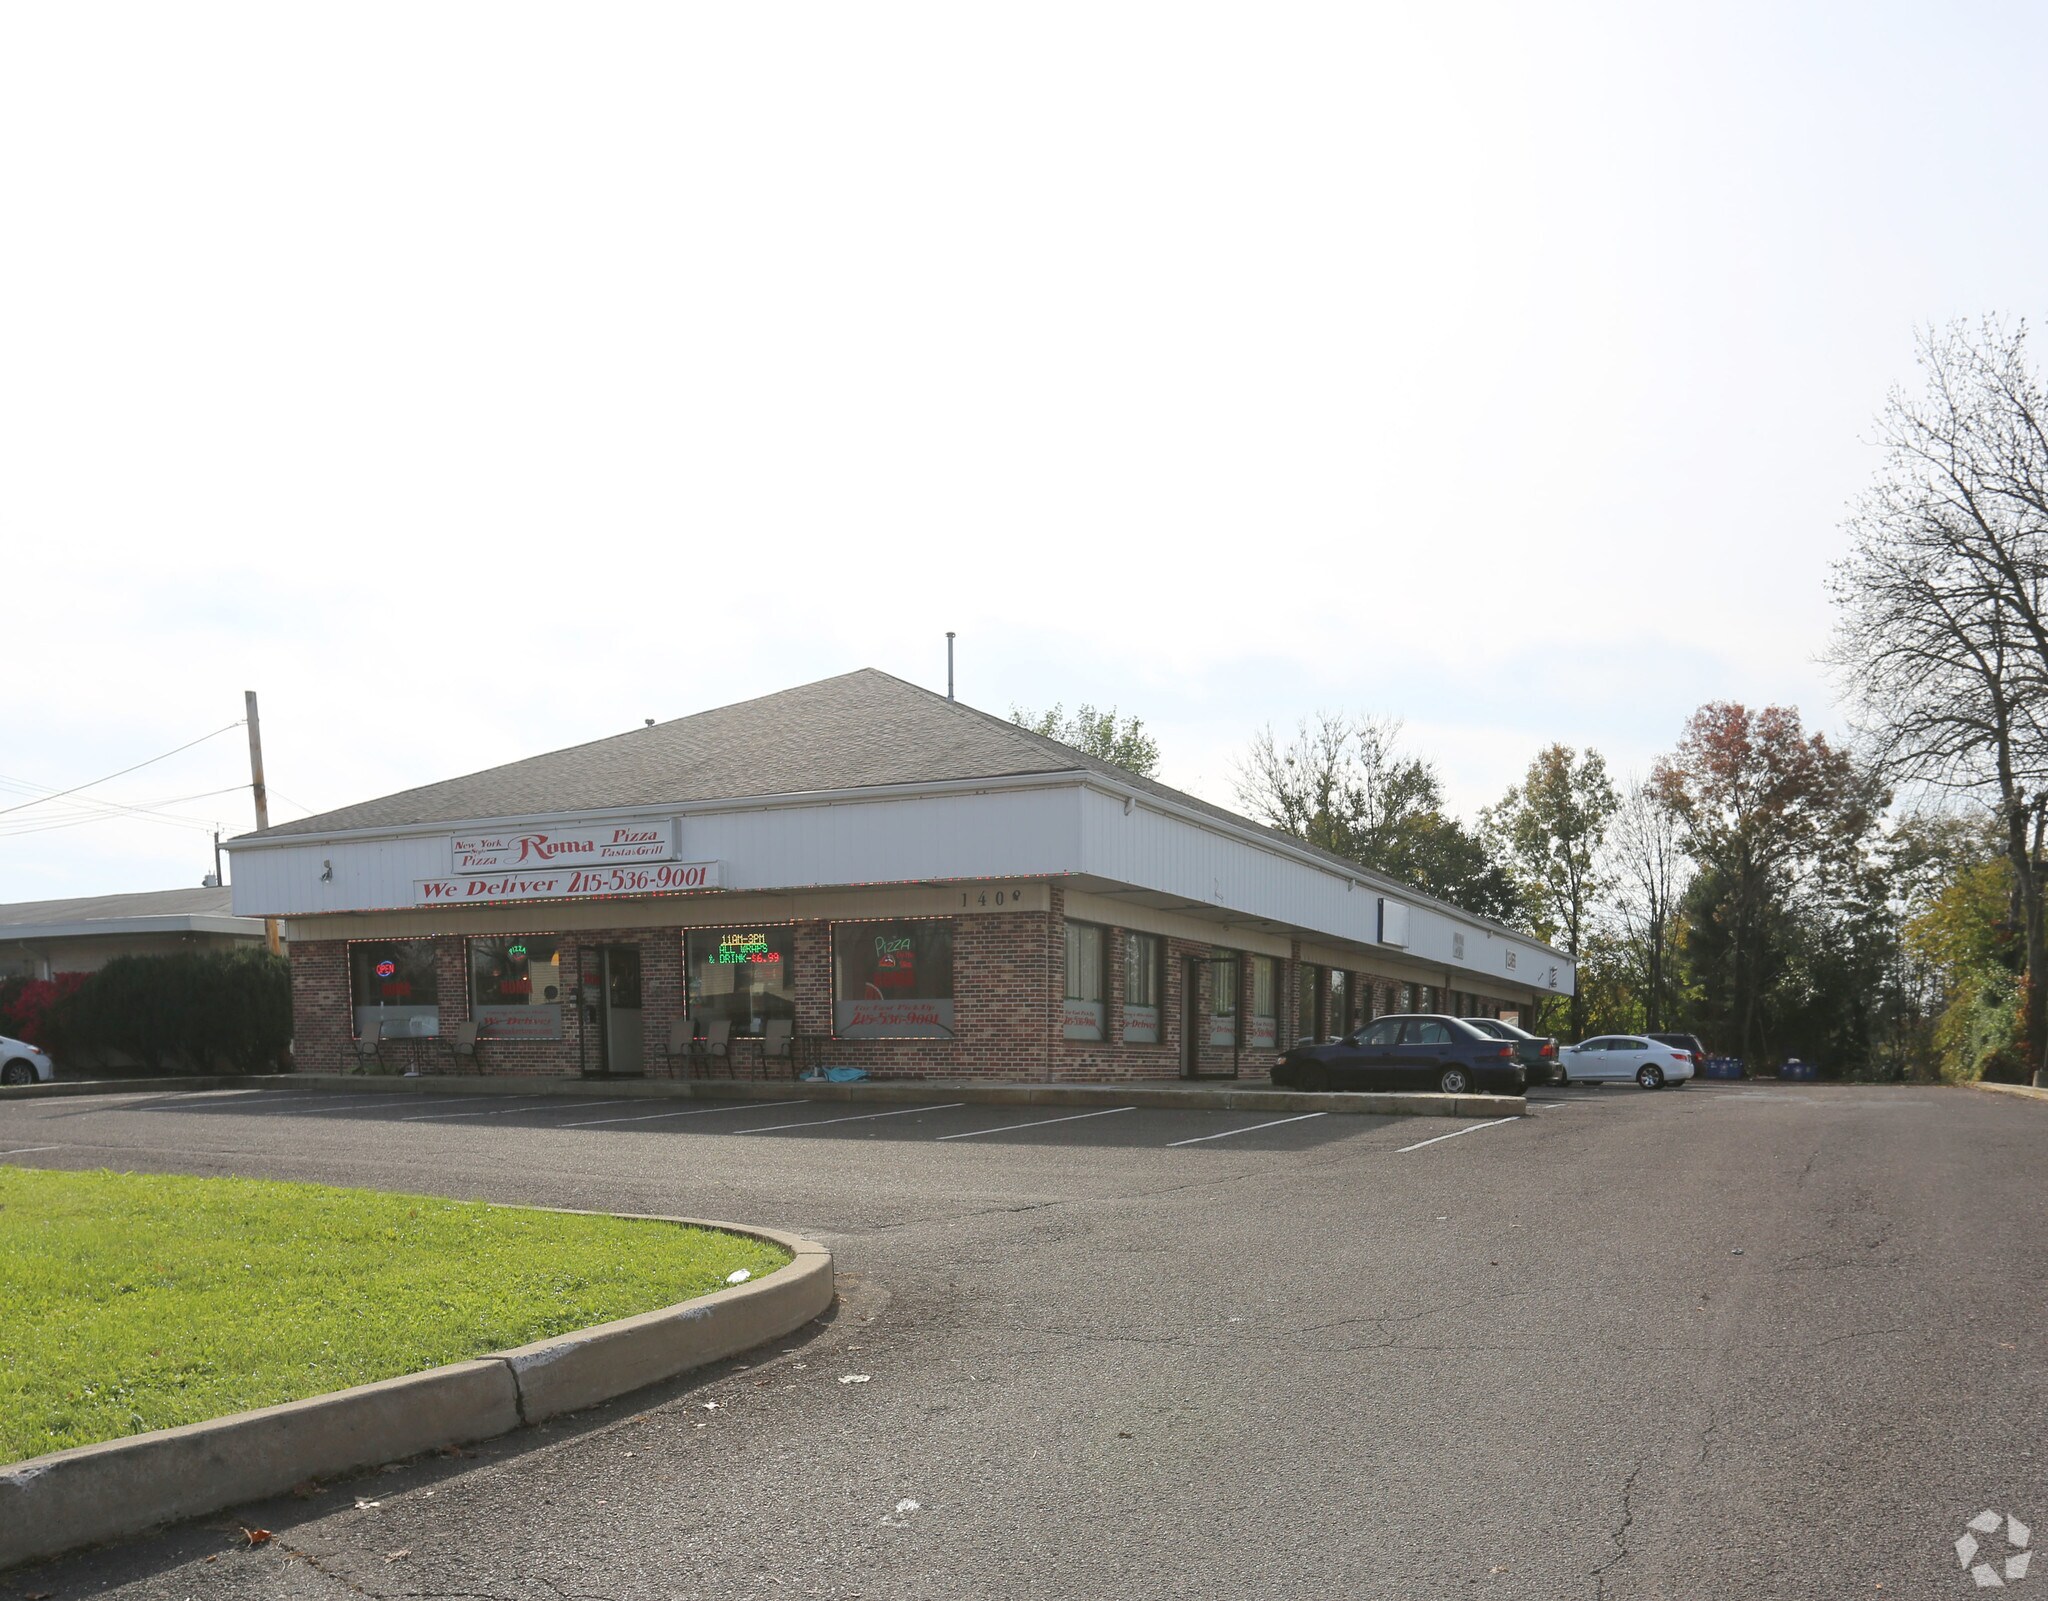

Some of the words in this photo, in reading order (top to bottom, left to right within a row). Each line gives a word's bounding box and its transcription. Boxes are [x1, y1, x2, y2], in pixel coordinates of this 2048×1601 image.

[612, 828, 658, 843] Pizza
[455, 841, 476, 850] New
[481, 839, 502, 848] York
[503, 834, 595, 865] Roma
[462, 855, 497, 866] Pizza
[423, 883, 457, 898] We
[466, 875, 559, 897] Deliver
[567, 865, 708, 893] 215-536-9001
[508, 945, 527, 955] PIZZA
[719, 944, 736, 954] ALL
[740, 943, 768, 953] WRAPS
[376, 963, 395, 975] OPEN
